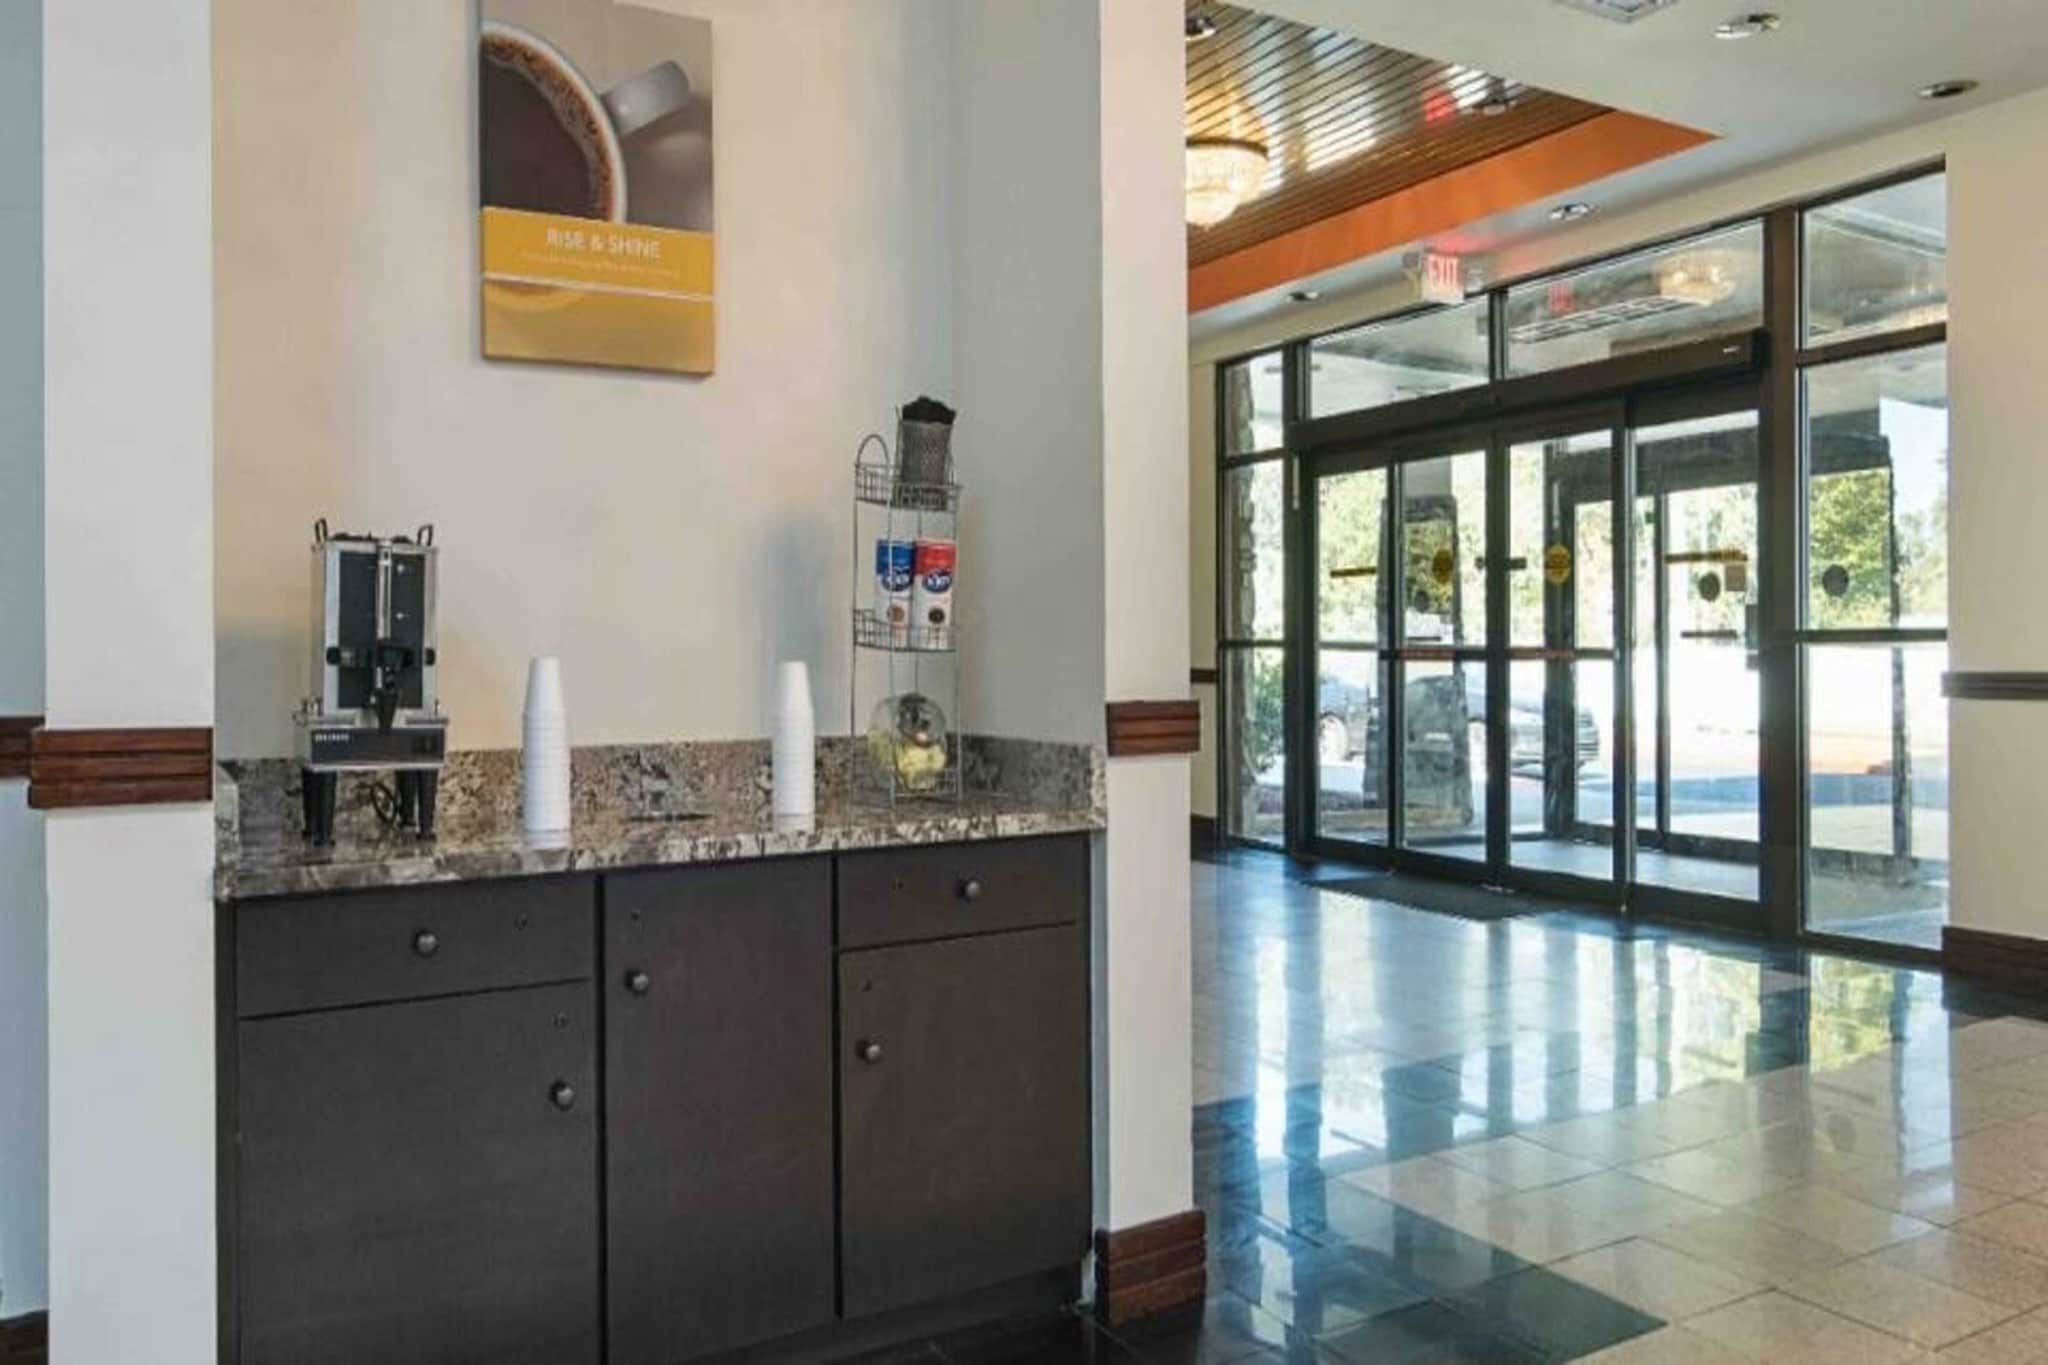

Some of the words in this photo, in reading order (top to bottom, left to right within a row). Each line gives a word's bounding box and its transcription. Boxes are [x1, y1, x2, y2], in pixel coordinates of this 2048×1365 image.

[546, 229, 584, 250] RISE
[590, 236, 603, 253] &
[608, 235, 661, 259] SHINE
[1427, 254, 1459, 287] EXIT
